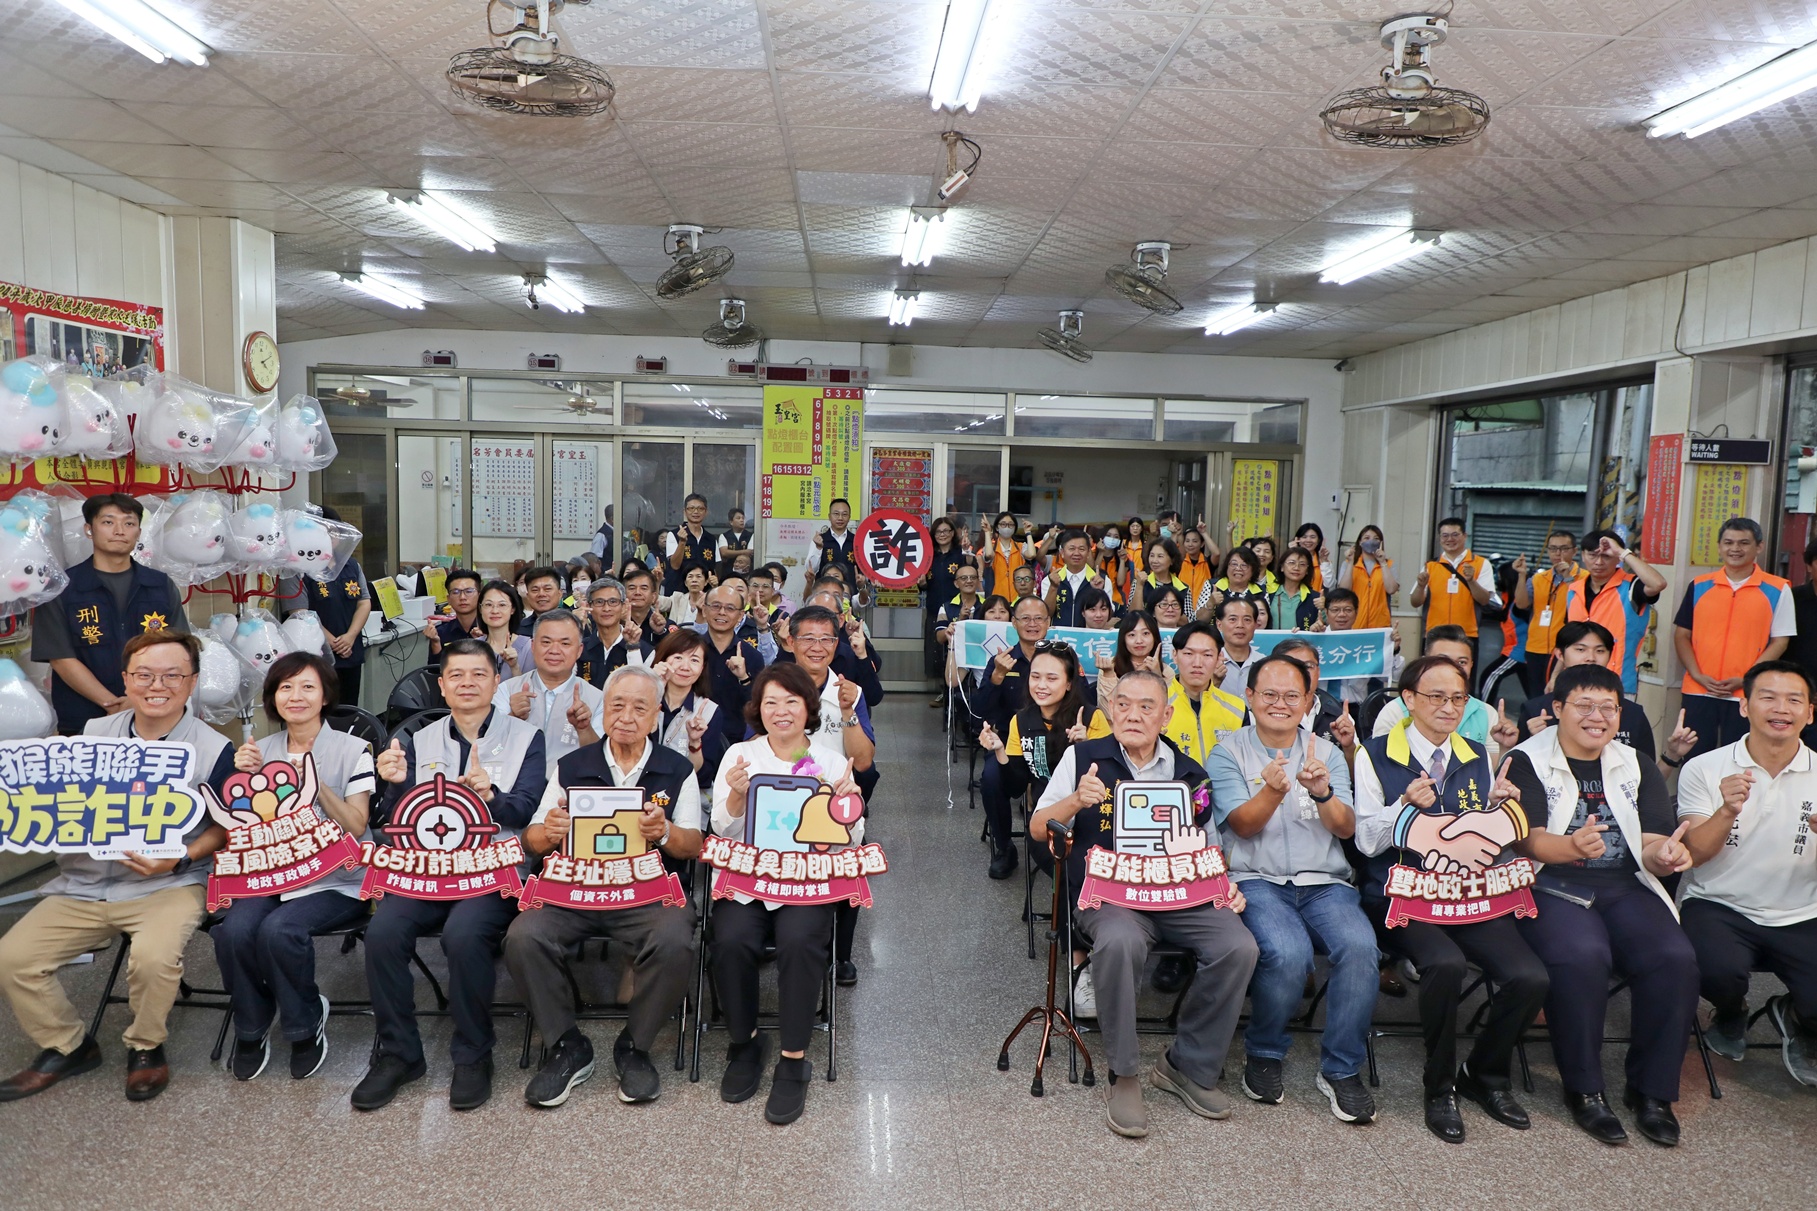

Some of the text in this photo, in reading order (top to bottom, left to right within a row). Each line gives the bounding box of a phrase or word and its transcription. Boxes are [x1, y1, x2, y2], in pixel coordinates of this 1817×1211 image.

[825, 389, 832, 398] 5
[835, 389, 842, 398] 3
[845, 389, 851, 398] 2
[815, 400, 821, 408] 6
[774, 403, 802, 424] 玉皇宮
[815, 410, 821, 419] 7
[815, 421, 821, 430] 8
[767, 429, 809, 441] 點燈櫃台
[815, 433, 821, 441] 9
[772, 442, 803, 453] 配置圖
[813, 444, 822, 453] 10
[1691, 444, 1720, 452] 等待人數
[813, 455, 822, 464] 11
[773, 464, 812, 474] 16 15 13 12
[762, 475, 772, 484] 17
[762, 486, 772, 495] 18
[762, 497, 772, 506] 19
[762, 508, 772, 517] 20
[869, 518, 921, 577] 詐
[76, 605, 103, 645] 刑警
[0, 742, 189, 785] 猴熊聯手
[837, 795, 852, 819] 1
[1457, 788, 1470, 811] 地政
[0, 783, 194, 844] 防詐中
[228, 806, 320, 851] 主動關懷
[1793, 800, 1813, 856] 嘉義市議員
[215, 819, 343, 876] 高風險案件
[361, 839, 524, 876] 165打詐儀錶板
[701, 836, 887, 881] 地籍異動即時通
[1088, 848, 1227, 884] 智能櫃員機
[246, 857, 323, 890] 地政警政聯手
[543, 852, 665, 886] 住址隱匿
[386, 873, 497, 893] 詐騙資訊 一目瞭然
[753, 879, 831, 898] 產權即時掌握
[1388, 860, 1536, 900] 雙地政士服務
[569, 888, 636, 902] 個資不外露
[1125, 887, 1188, 902] 數位雙驗證
[1431, 900, 1491, 917] 讓專業把關
